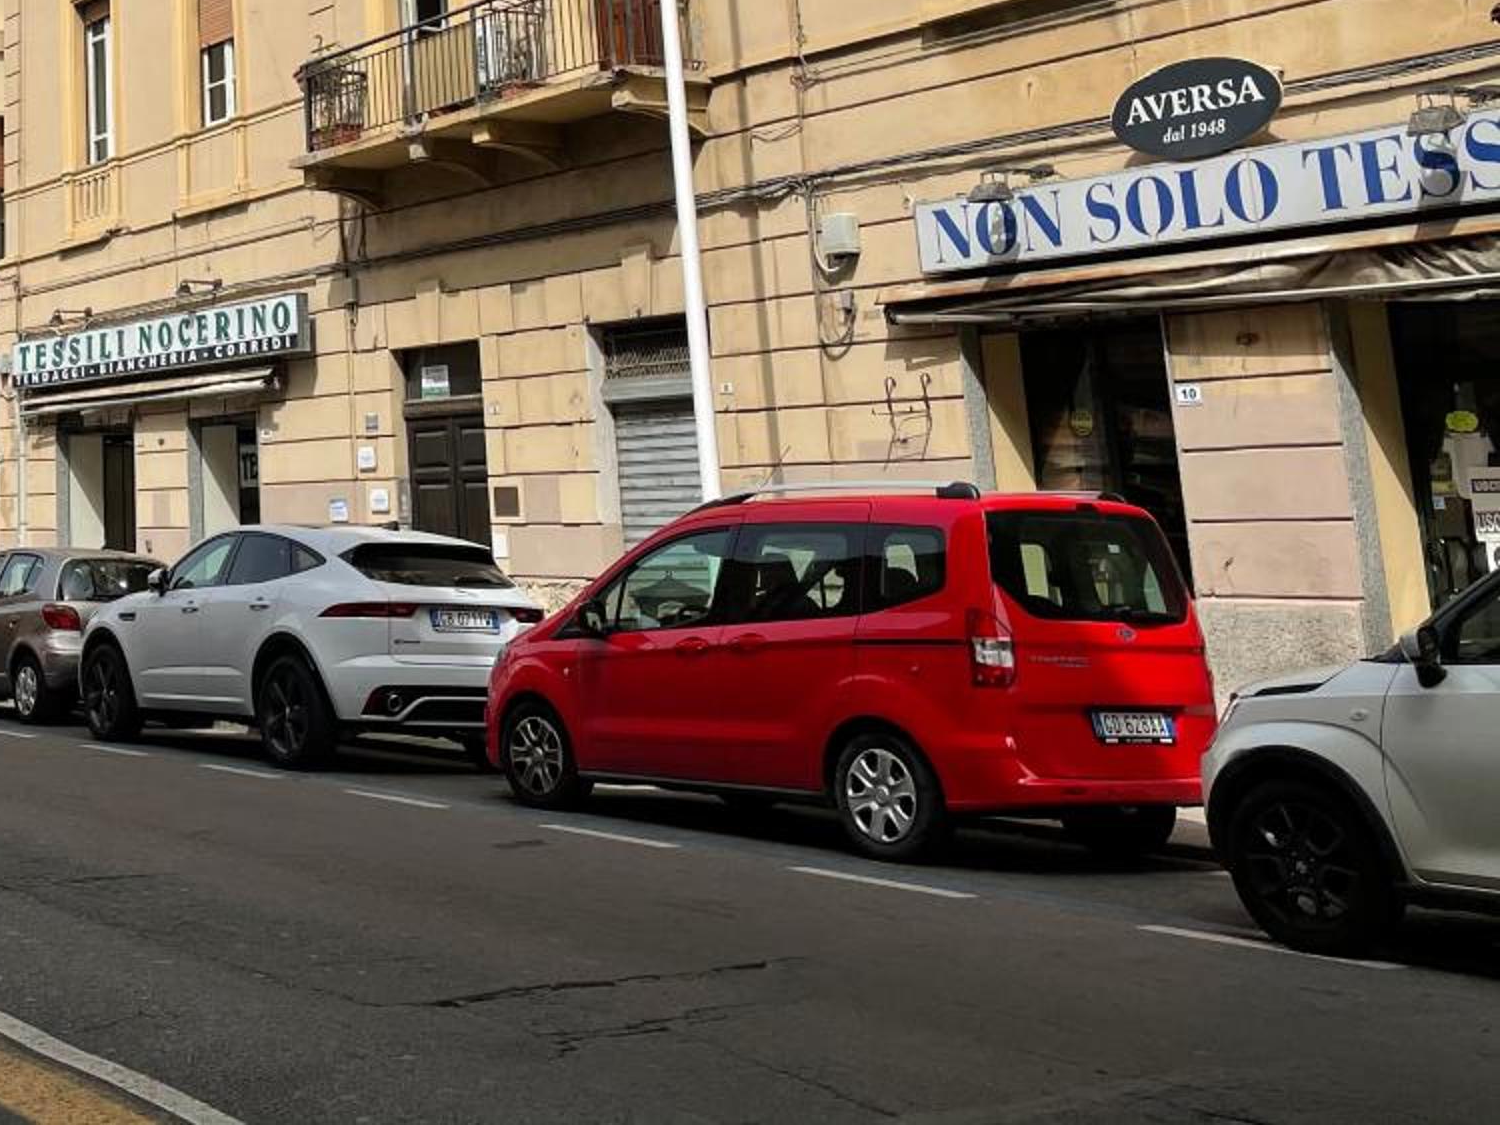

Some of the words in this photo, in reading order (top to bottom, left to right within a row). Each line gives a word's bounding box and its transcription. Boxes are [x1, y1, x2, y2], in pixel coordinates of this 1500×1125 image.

[1125, 75, 1265, 126] AVERSA
[1162, 125, 1185, 144] dal
[1190, 118, 1227, 139] 1948
[931, 189, 1062, 263] NON
[1086, 158, 1279, 244] SOLO
[16, 367, 86, 386] TENDAGGI
[99, 350, 197, 375] BIANCHERIA
[213, 335, 291, 358] CORREDI
[19, 329, 125, 372] TESSILI
[138, 301, 291, 354] NOCERINO
[1181, 388, 1197, 400] 10
